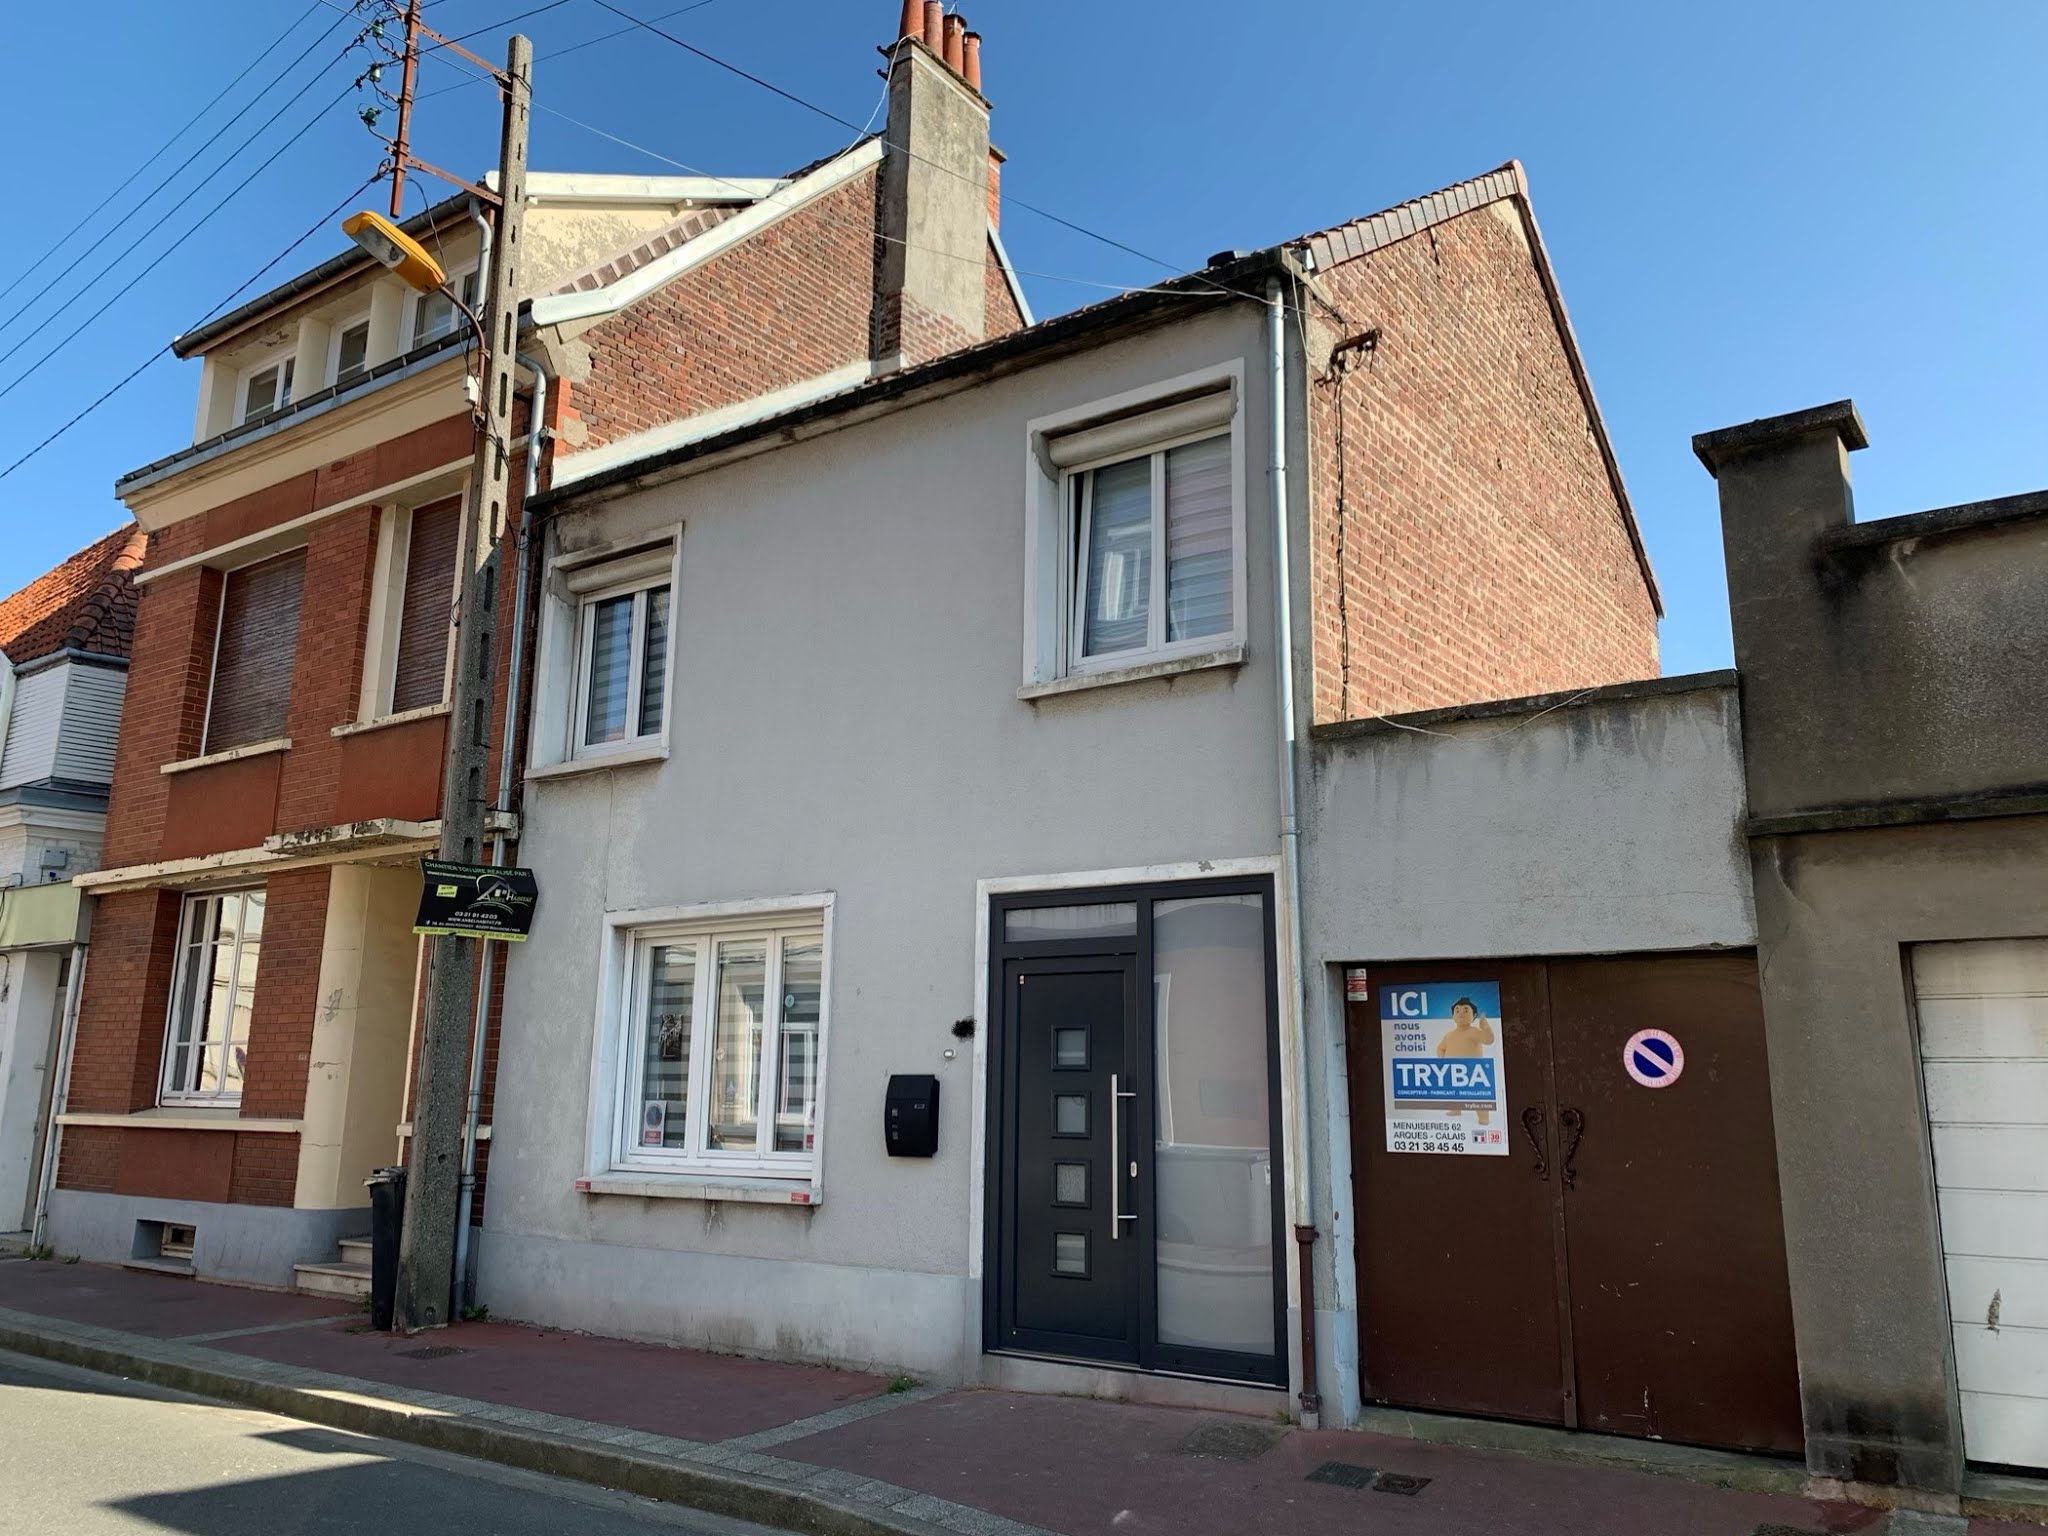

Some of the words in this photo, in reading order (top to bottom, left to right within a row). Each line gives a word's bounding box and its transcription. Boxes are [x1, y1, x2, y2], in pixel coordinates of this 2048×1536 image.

[425, 861, 458, 871] CHANTIER
[1391, 991, 1428, 1016] ICI
[1394, 1022, 1420, 1031] nous
[1394, 1033, 1426, 1041] avons
[1395, 1042, 1426, 1052] choisi
[1396, 1063, 1491, 1087] TRYBA
[1393, 1122, 1450, 1131] MENUISERIES
[1452, 1123, 1461, 1131] 62
[1393, 1131, 1428, 1140] ARQUES
[1435, 1132, 1466, 1140] CALAIS
[1394, 1142, 1406, 1151] 03
[1408, 1142, 1419, 1151] 21
[1423, 1142, 1435, 1151] 38
[1437, 1143, 1449, 1152] 45
[1452, 1143, 1464, 1152] 45
